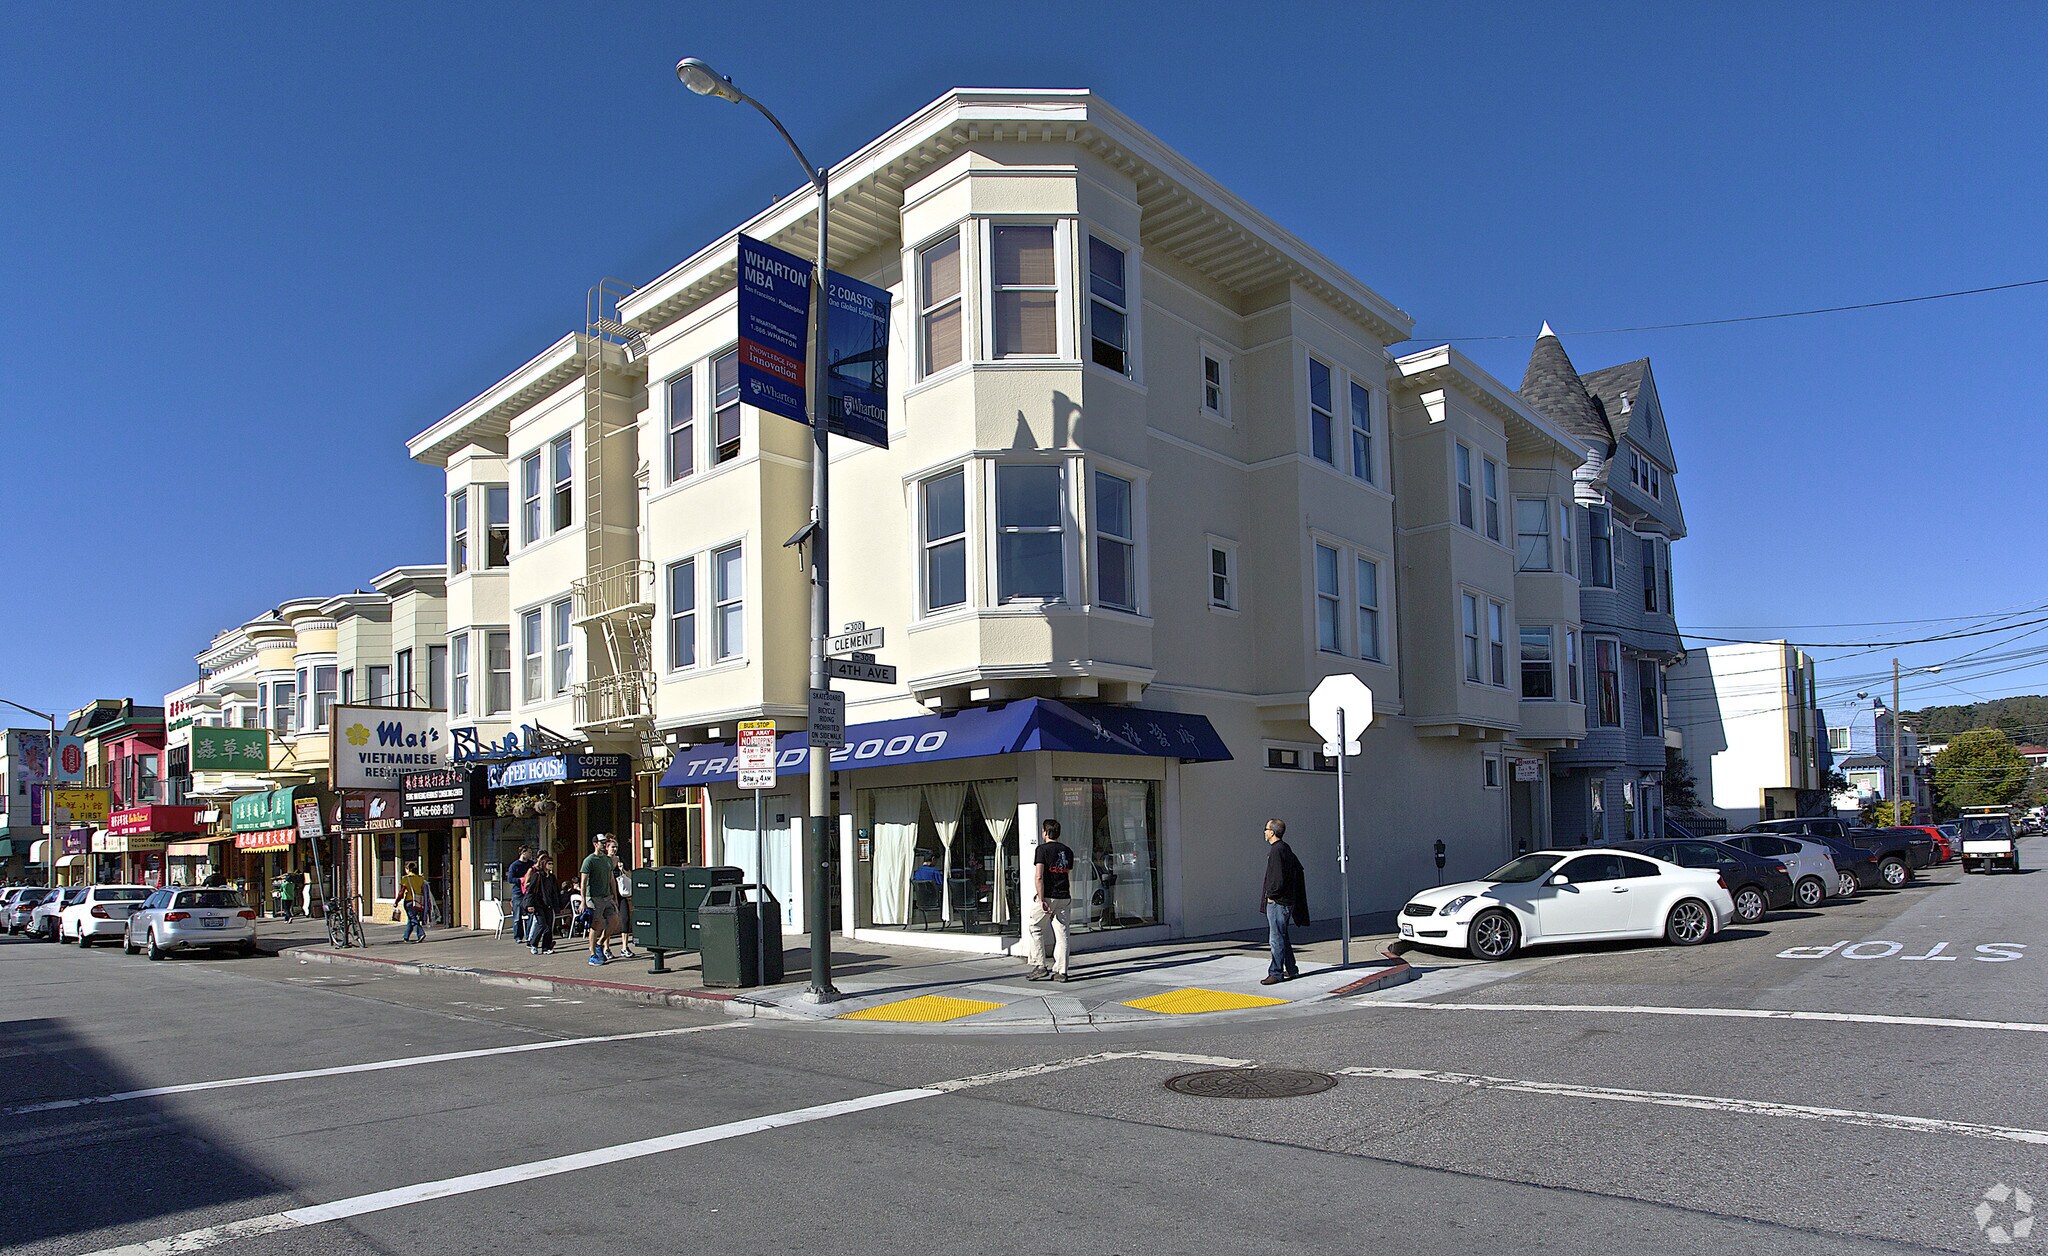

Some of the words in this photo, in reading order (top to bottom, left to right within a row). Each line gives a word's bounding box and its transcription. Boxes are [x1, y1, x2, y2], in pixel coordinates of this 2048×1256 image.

[744, 249, 807, 288] WHARTON
[745, 266, 774, 291] MBA
[828, 298, 840, 308] One
[840, 301, 858, 313] Global
[829, 284, 836, 296] 2
[838, 287, 874, 309] COASTS
[749, 345, 785, 365] KNOWLEDGE
[786, 360, 798, 371] FOR
[749, 352, 797, 380] Innovation
[761, 383, 797, 406] Wharton
[852, 397, 887, 422] Wharton
[835, 633, 873, 651] CLEMENT
[839, 665, 860, 677] 4TH
[867, 668, 889, 679] AVE
[813, 692, 841, 701] SKATEBOARD
[818, 707, 836, 715] BICYCLE
[376, 720, 439, 748] Mai's
[814, 723, 839, 731] PROHIBITED
[820, 732, 842, 740] SIDEWALK
[197, 738, 264, 762] 蟲草城
[741, 737, 751, 746] NO
[358, 752, 437, 764] VIETNAMESE
[578, 756, 619, 766] COFFEE
[688, 748, 808, 777] TRED
[830, 730, 948, 762] 2000
[365, 767, 430, 777] RESTAU
[529, 758, 565, 779] HOUSE
[581, 769, 618, 778] HOUSE
[1775, 940, 2027, 962] STOP
